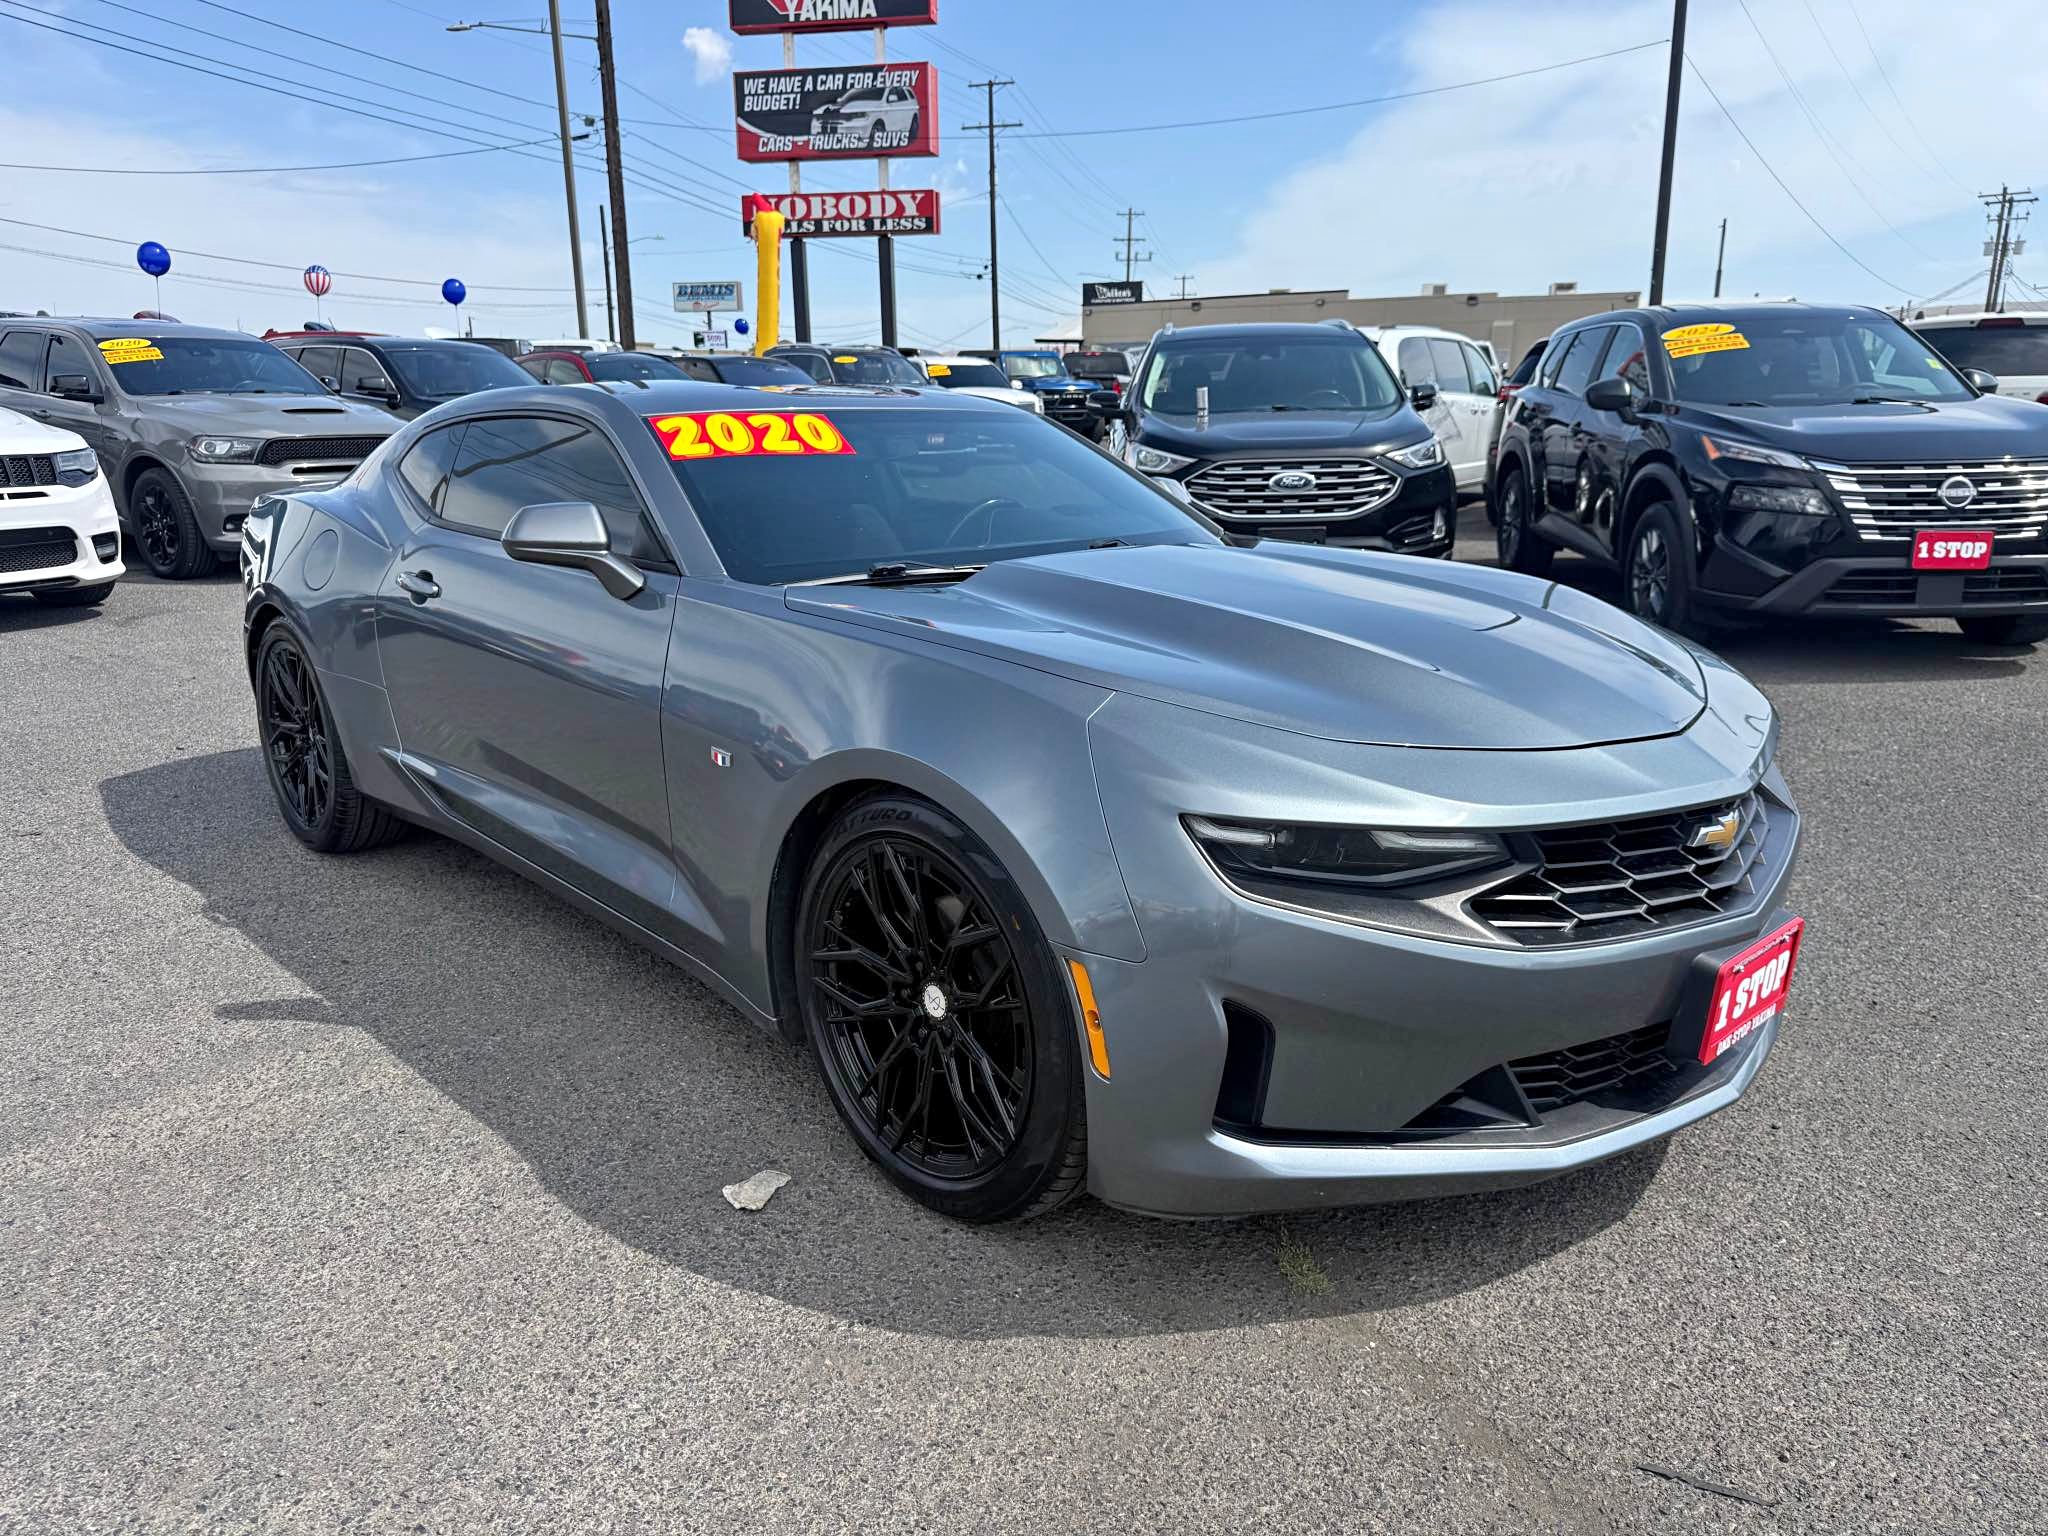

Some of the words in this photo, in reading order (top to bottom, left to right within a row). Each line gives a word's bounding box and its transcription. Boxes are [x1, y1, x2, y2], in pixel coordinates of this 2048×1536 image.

[787, 0, 878, 23] YAKIMA
[743, 78, 767, 95] WE
[768, 76, 802, 94] HAVE
[804, 75, 814, 92] A
[816, 73, 844, 91] CAR
[846, 72, 874, 89] FOR
[876, 70, 920, 89] EVERY
[744, 93, 801, 112] BUDGET!
[758, 135, 794, 153] CARS
[808, 132, 860, 151] TRUCKS
[872, 131, 910, 148] SUVS
[822, 219, 867, 232] FOR
[872, 217, 927, 231] LESS
[655, 413, 843, 458] 2020
[1917, 541, 1929, 558] 1
[1932, 541, 1988, 558] STOP
[1714, 989, 1732, 1032] 1
[1731, 950, 1791, 1020] STOP
[1731, 1020, 1752, 1045] STOP
